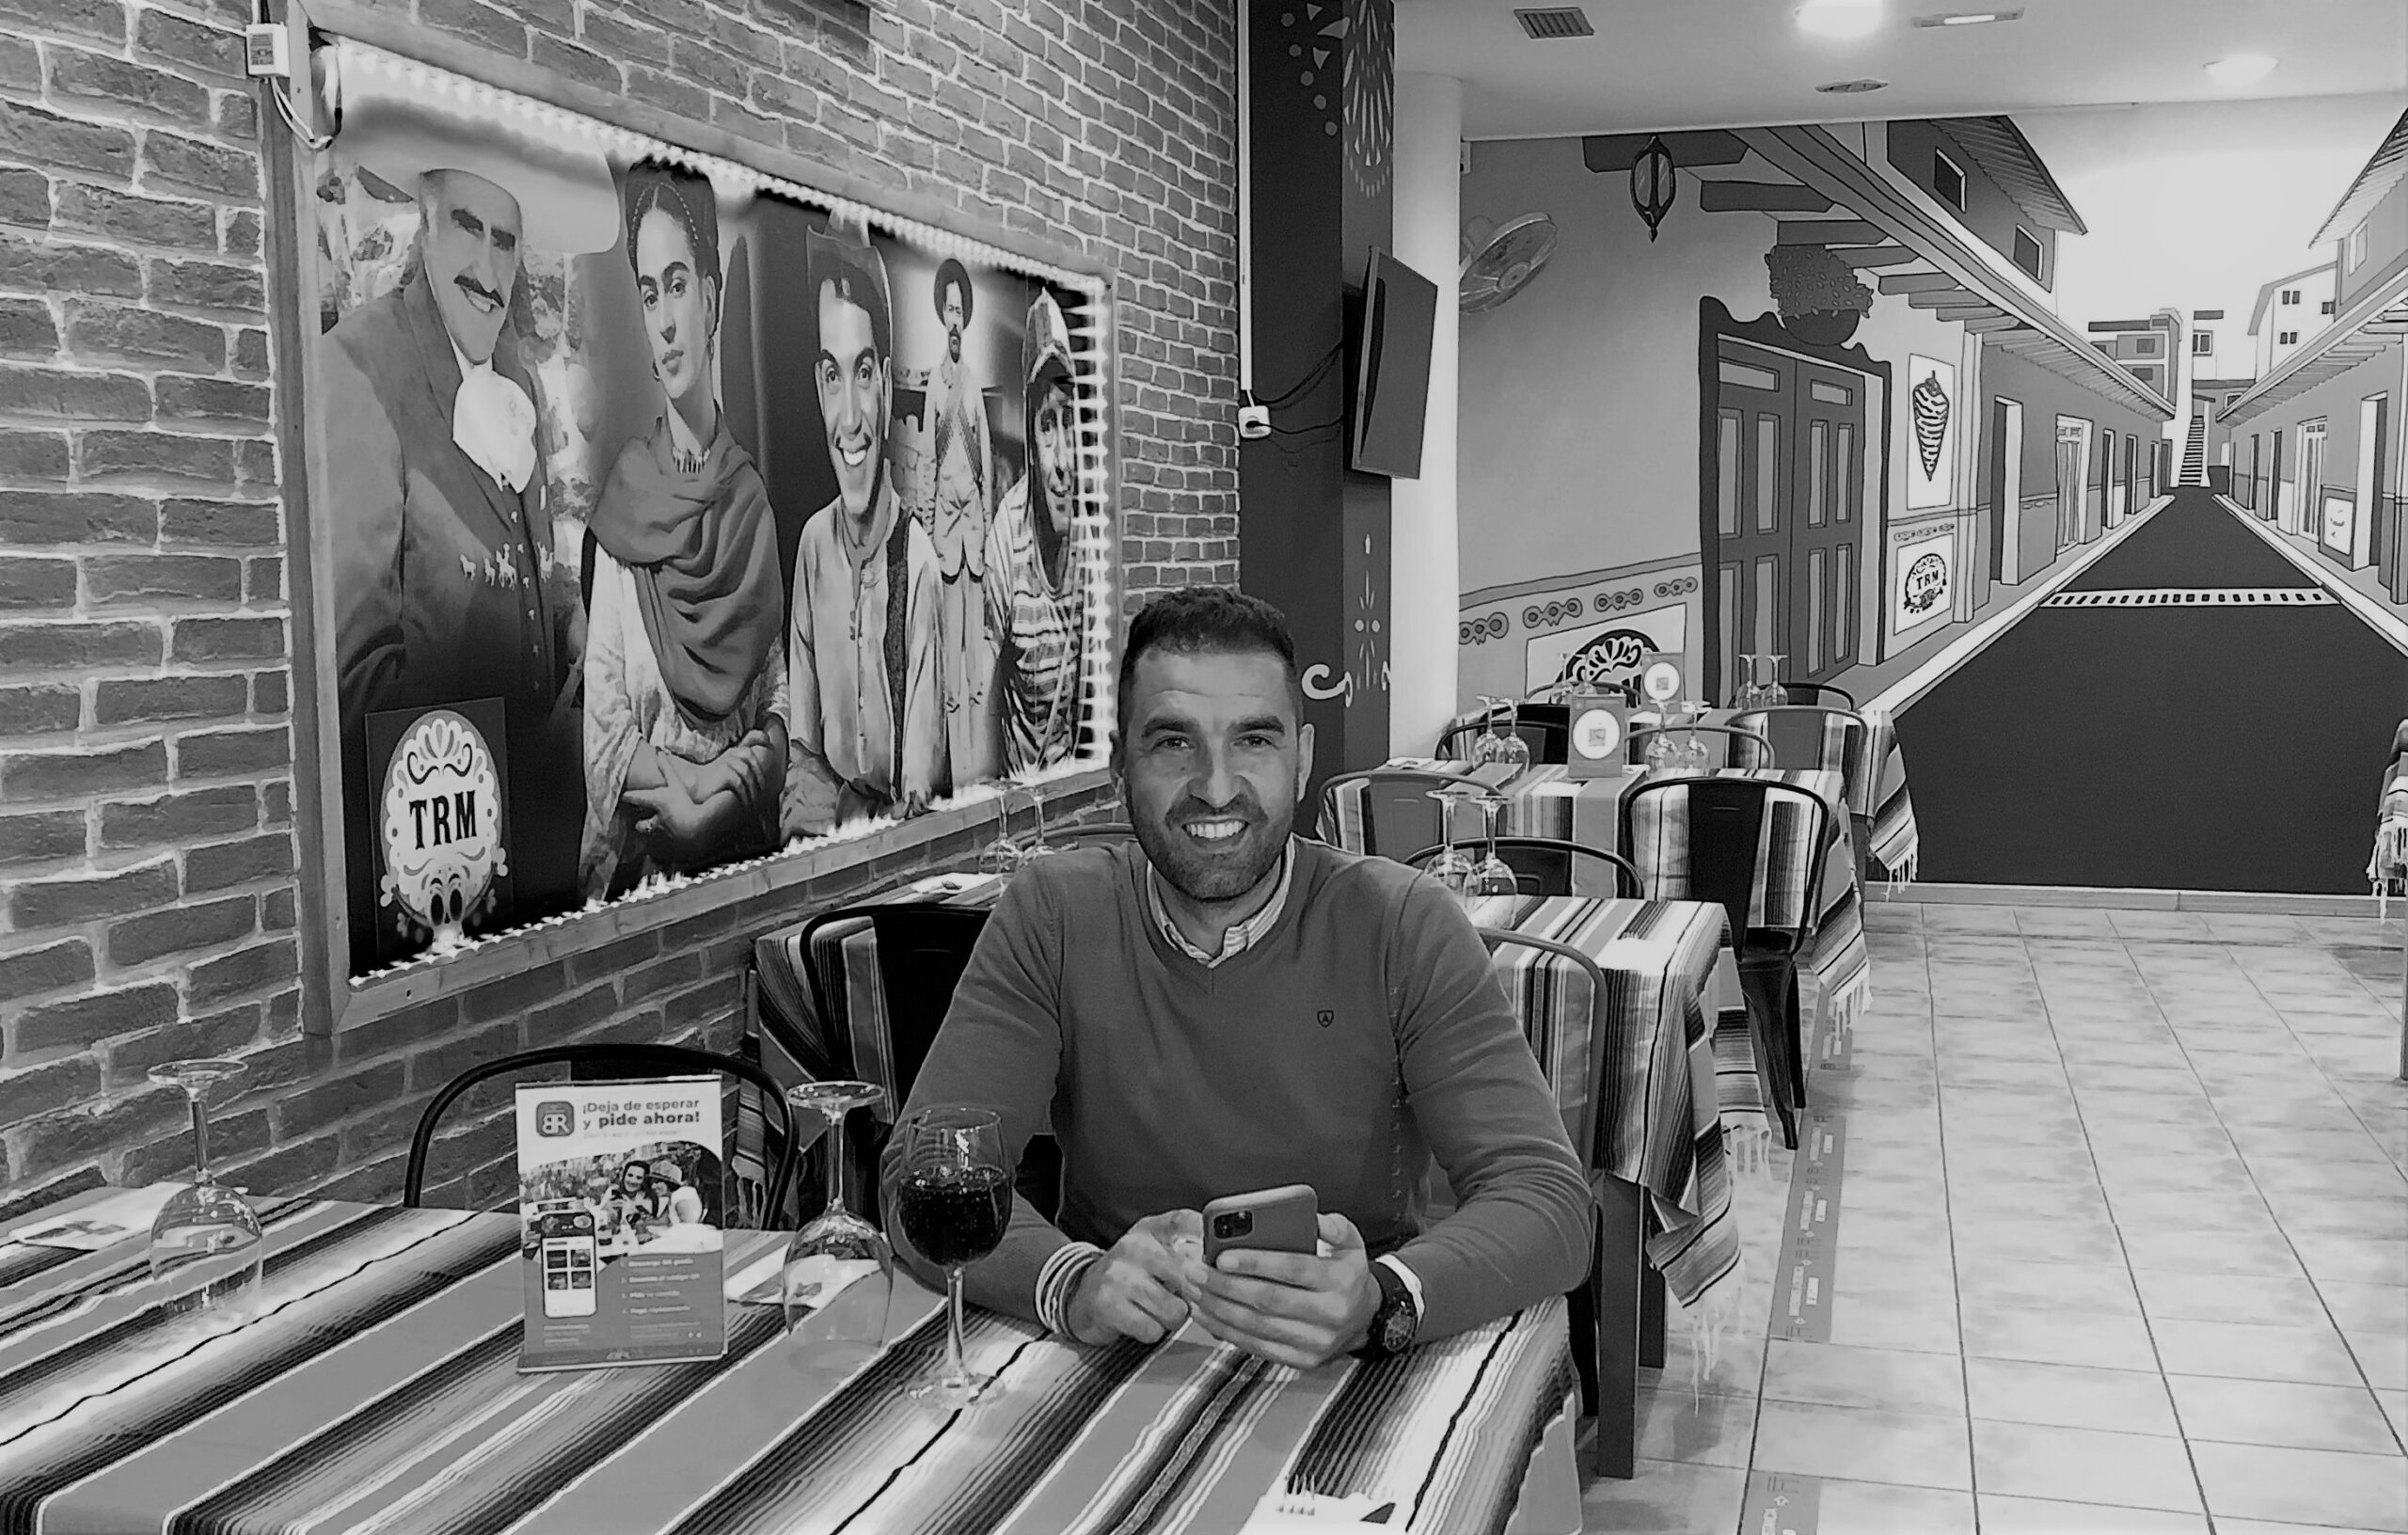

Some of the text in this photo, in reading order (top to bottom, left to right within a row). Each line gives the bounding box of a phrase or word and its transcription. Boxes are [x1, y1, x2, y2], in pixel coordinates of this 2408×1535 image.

[409, 790, 477, 849] TRM
[583, 1100, 700, 1114] ¡Deja de esperar
[583, 1112, 700, 1130] y pide ahora!
